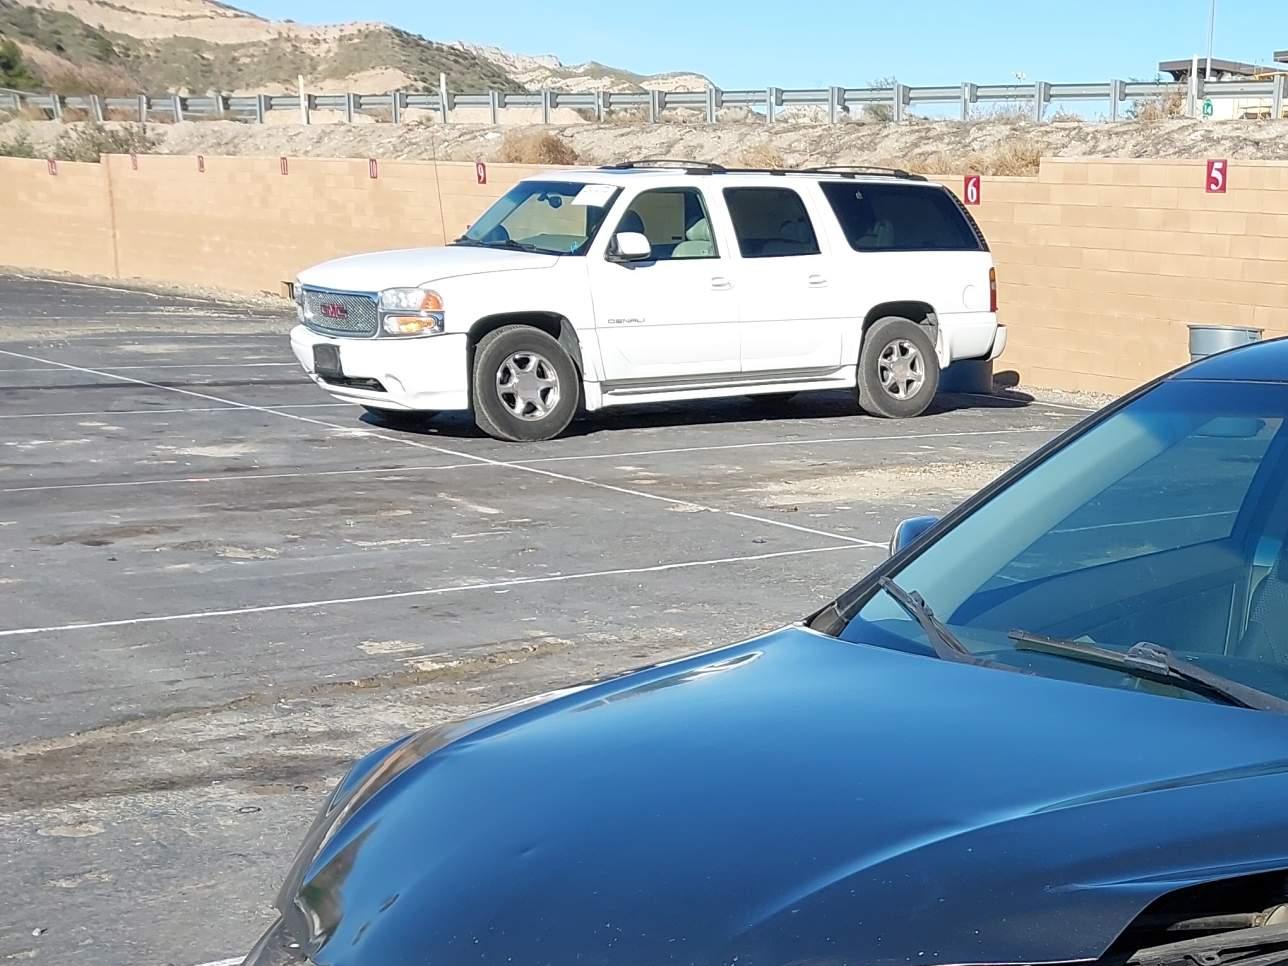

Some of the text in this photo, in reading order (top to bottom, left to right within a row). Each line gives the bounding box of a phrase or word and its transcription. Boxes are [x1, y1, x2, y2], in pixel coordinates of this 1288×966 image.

[478, 164, 484, 182] 9
[1210, 162, 1223, 191] 5
[967, 177, 977, 203] 6
[320, 304, 348, 319] GMC
